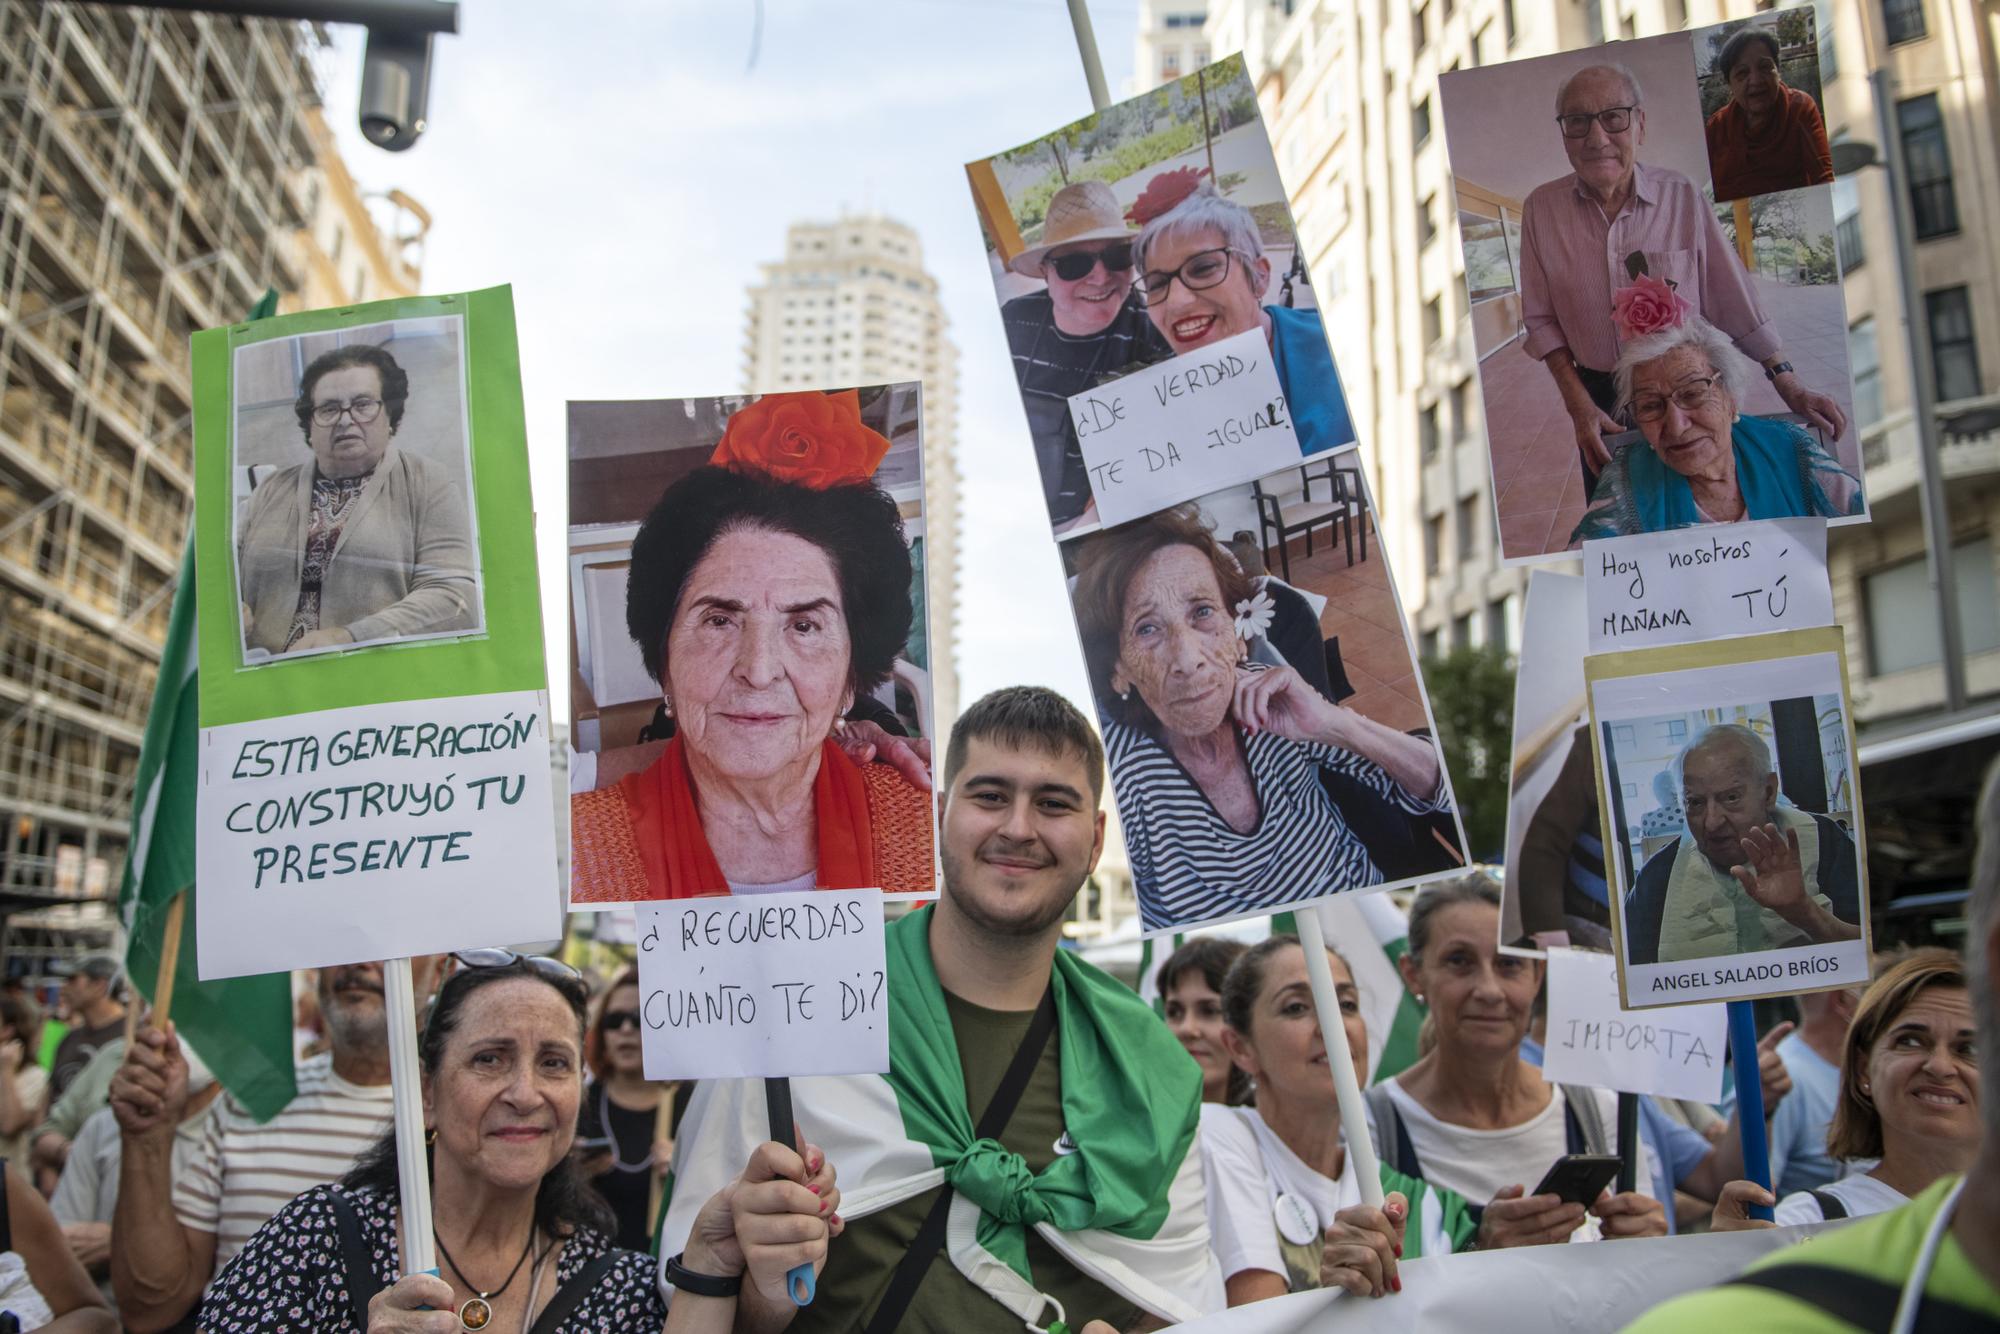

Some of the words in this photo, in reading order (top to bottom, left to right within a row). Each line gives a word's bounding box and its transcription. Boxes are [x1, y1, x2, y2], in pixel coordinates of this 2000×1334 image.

[1154, 355, 1257, 406] VERDAD,
[1090, 459, 1125, 491] TE
[1138, 441, 1181, 472] DA
[1207, 397, 1290, 449] IGUAL?
[1602, 552, 1644, 599] Hoy
[1603, 608, 1691, 636] MAÑANA
[1731, 574, 1787, 618] TÚ
[231, 735, 319, 779] ESTA
[327, 711, 537, 766] GENERACIÓN
[226, 772, 456, 834] CONSTRUYÓ
[466, 774, 526, 810] TU
[253, 831, 472, 889] PRESENTE
[681, 901, 864, 951] RECUERDAS
[644, 966, 756, 1029] CUÁNTO
[772, 982, 815, 1024] TE
[1652, 970, 1711, 992] ANGEL
[1714, 964, 1783, 986] SALADO
[1788, 956, 1839, 977] BRÍOS
[1562, 1019, 1713, 1068] IMPORTA
